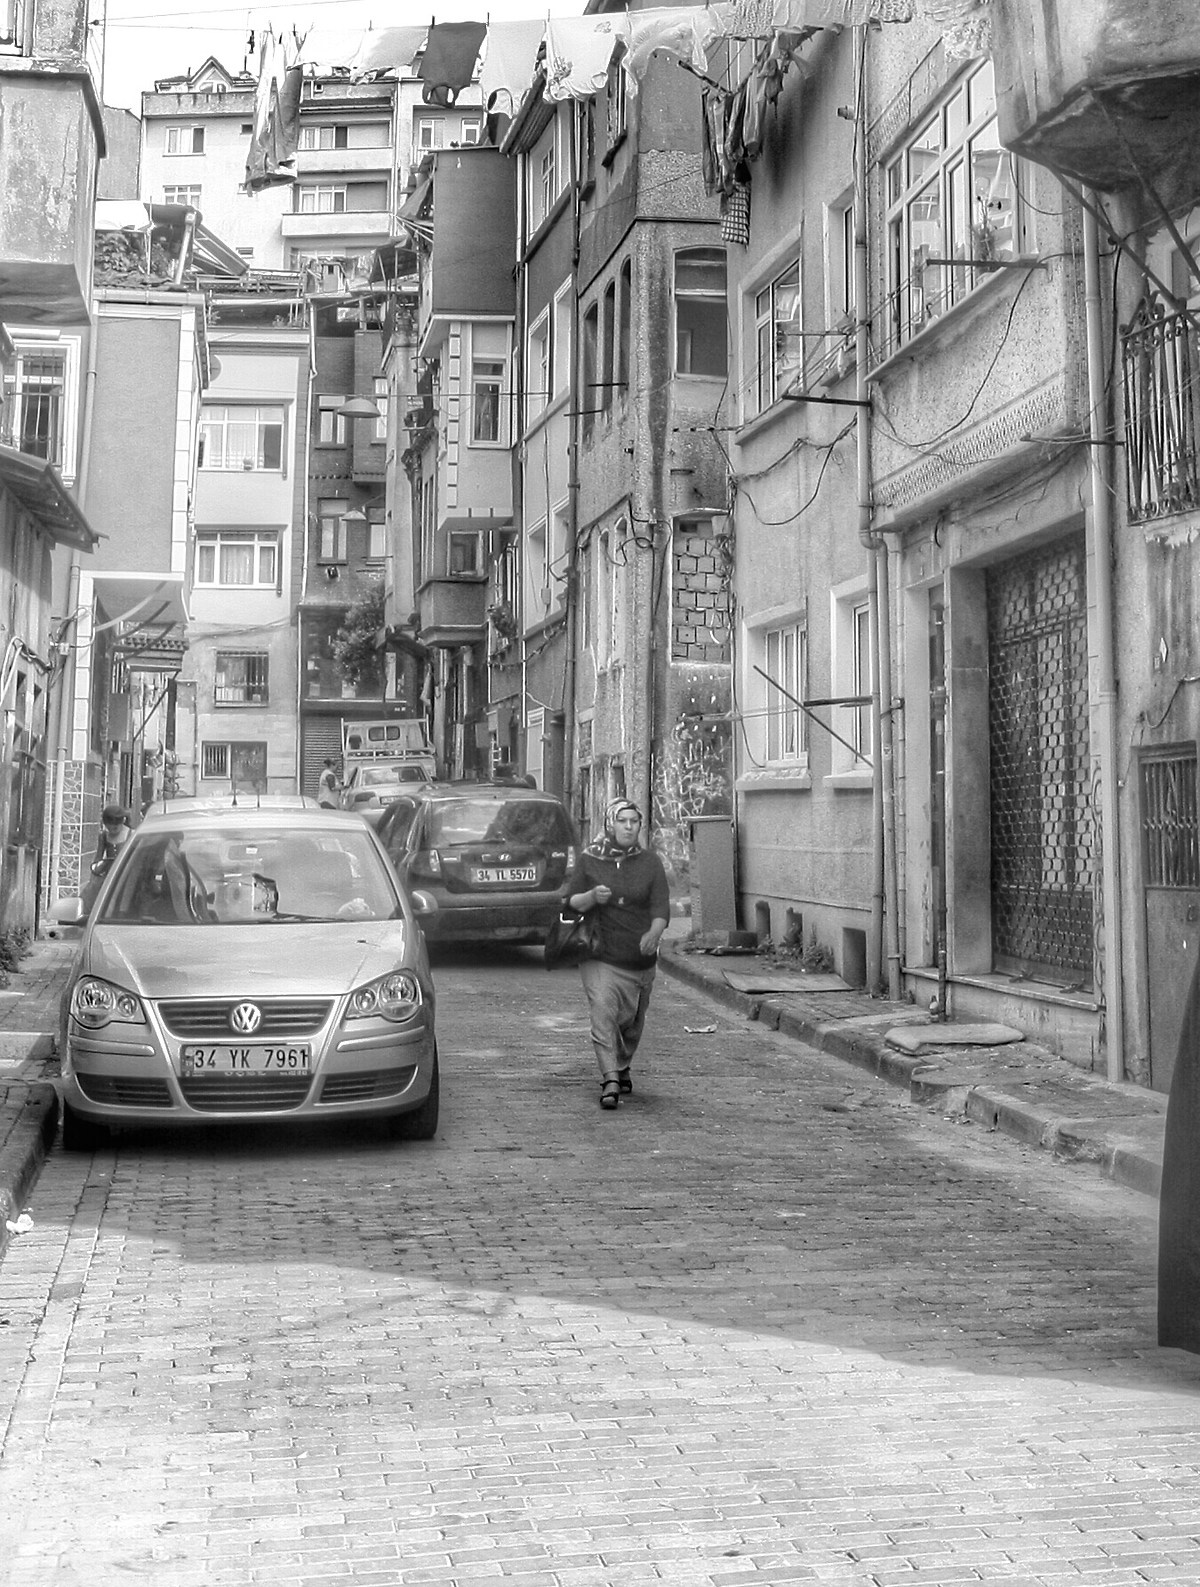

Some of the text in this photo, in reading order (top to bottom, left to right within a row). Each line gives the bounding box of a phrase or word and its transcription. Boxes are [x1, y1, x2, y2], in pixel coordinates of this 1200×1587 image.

[477, 869, 533, 881] 34 TL 5570
[195, 1049, 306, 1069] 34 YK 7961
